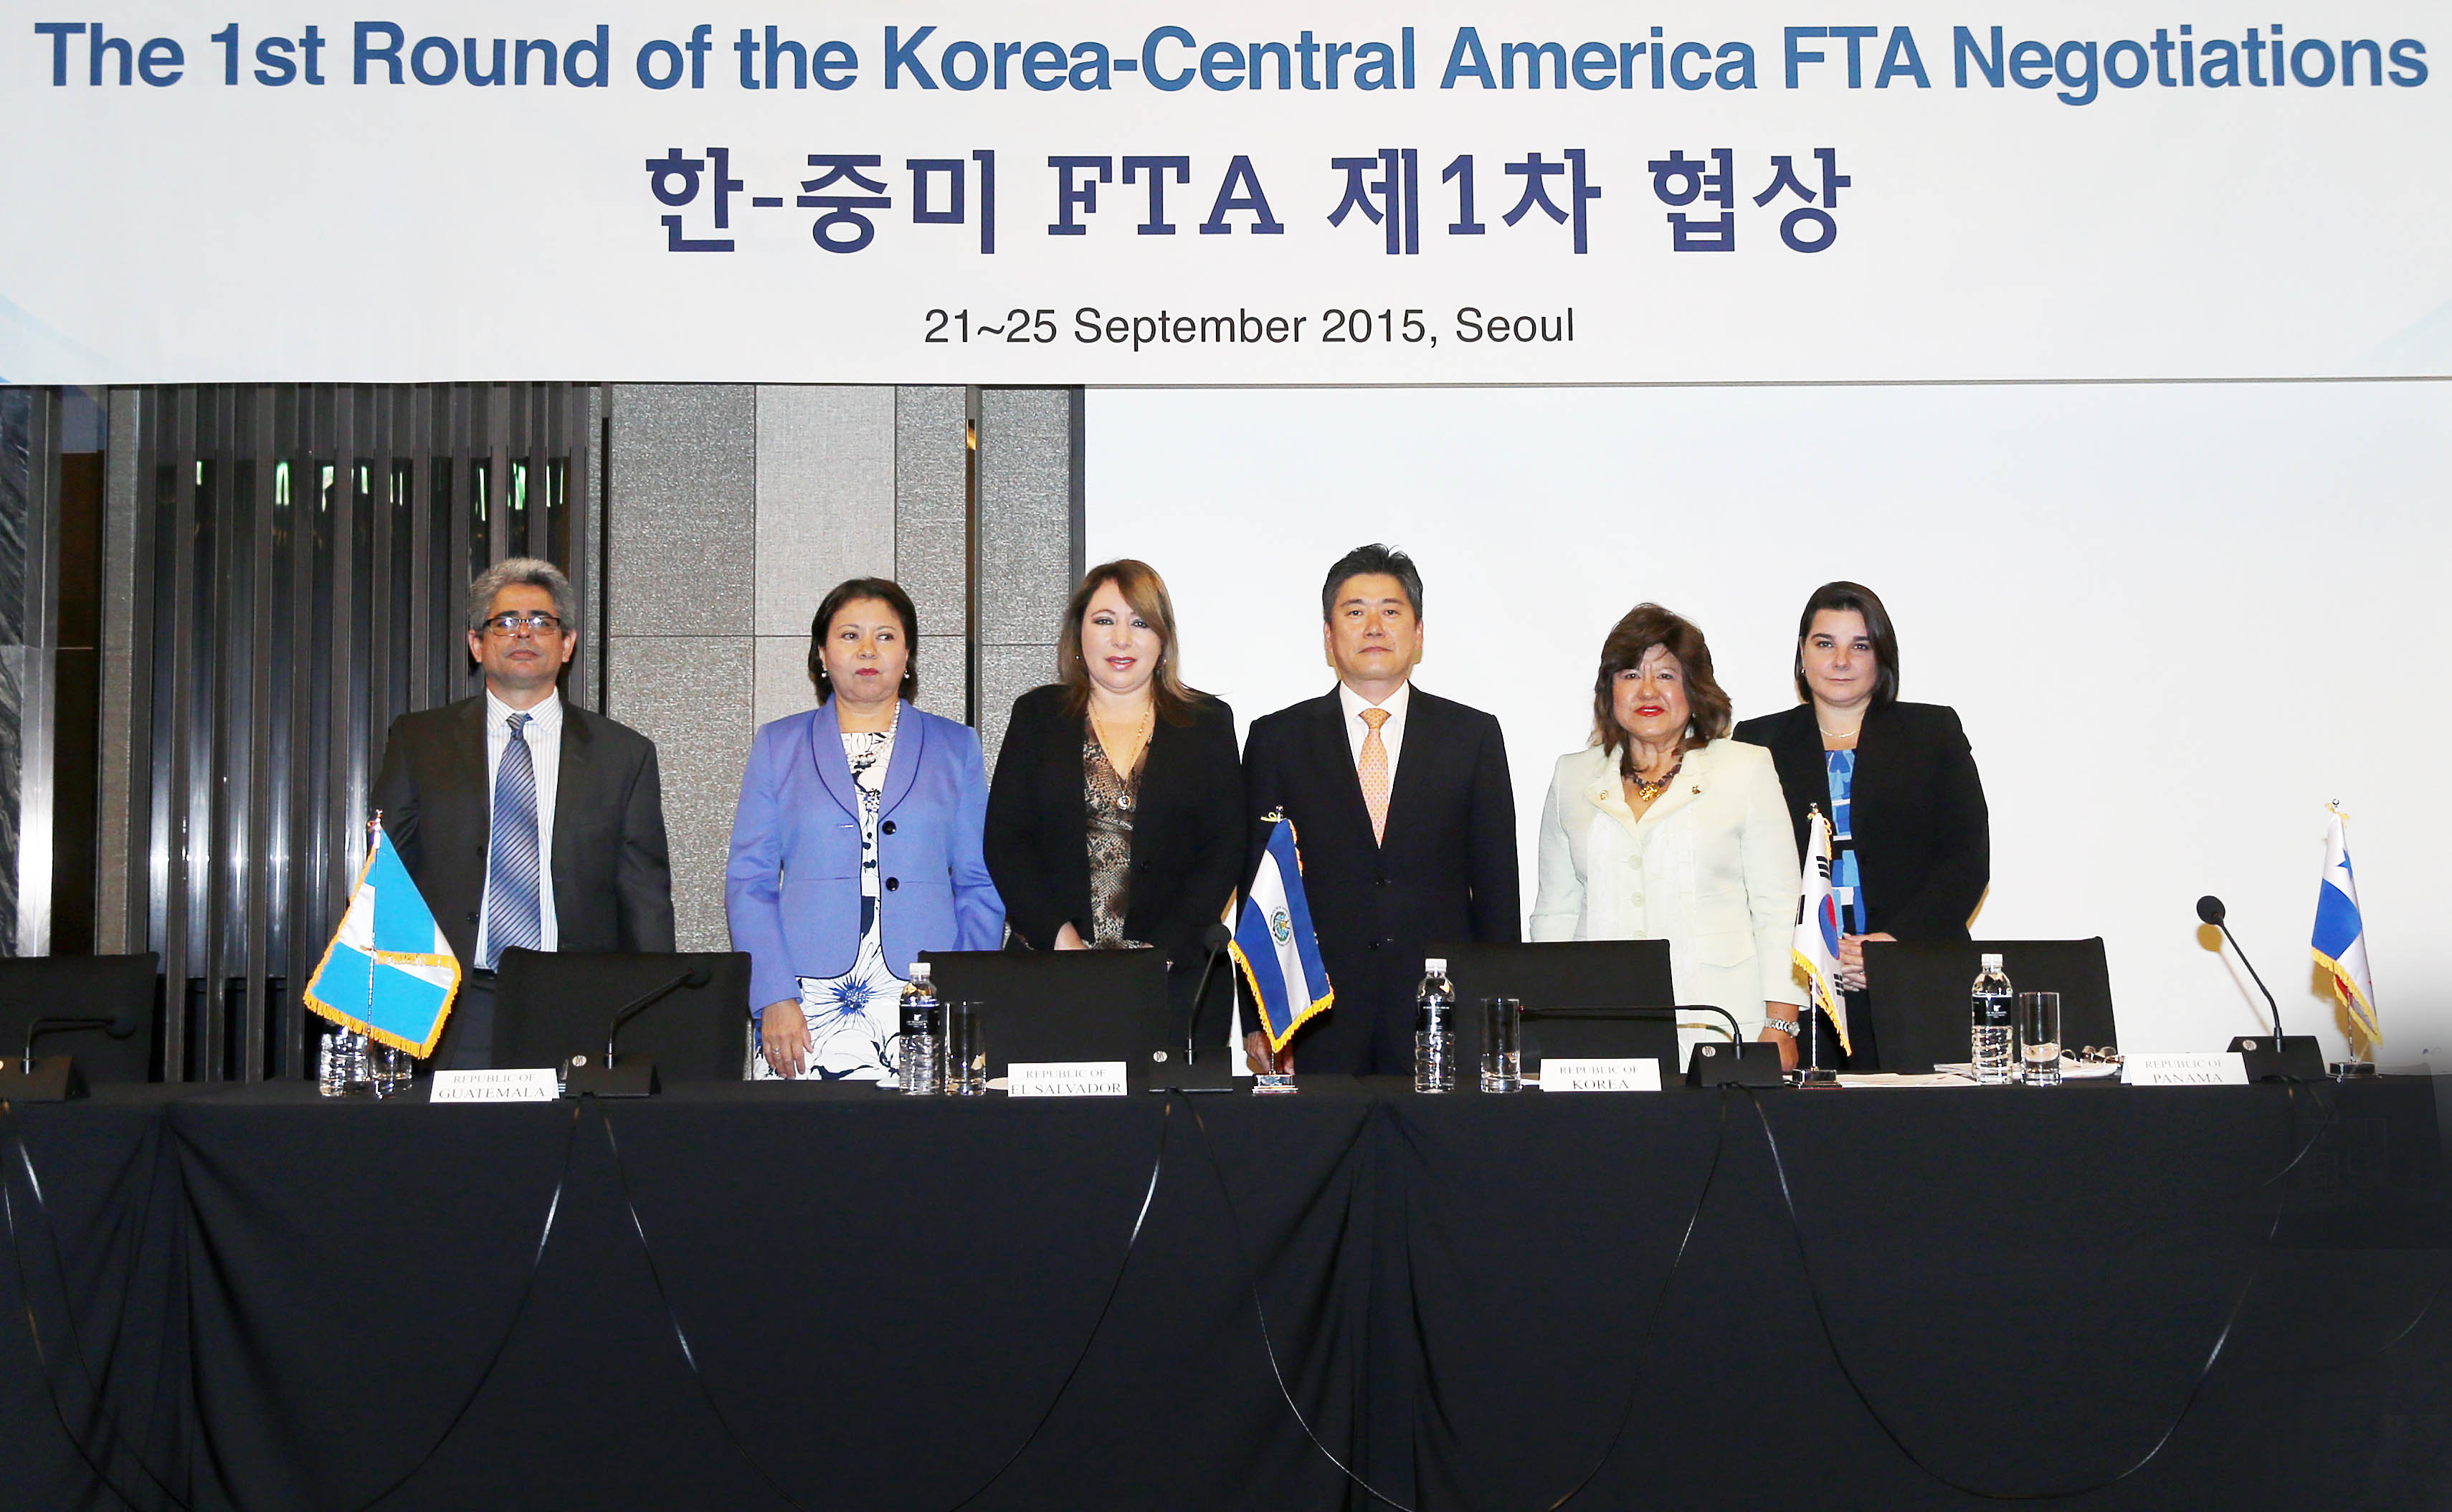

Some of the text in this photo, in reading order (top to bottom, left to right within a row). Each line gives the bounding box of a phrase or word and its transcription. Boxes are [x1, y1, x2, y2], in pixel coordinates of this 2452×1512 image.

[34, 21, 2428, 106] The 1st Round of the Korea-Central America FTA Negotiations
[646, 147, 1850, 255] 한-중미 FTA 제1차 협상
[925, 307, 1574, 352] 21~25 September 2015, Seoul
[2145, 1059, 2223, 1069] REPUBLIC OF
[1026, 1068, 1107, 1078] REPUBLIC OF
[1560, 1066, 1620, 1075] REPUBLIC
[454, 1073, 536, 1083] REPUBLIC OF
[2153, 1073, 2224, 1084] PANAMA
[1012, 1083, 1121, 1095] EL SALVADOR
[1573, 1079, 1629, 1090] KOREA
[439, 1087, 546, 1098] GUATEMALA
